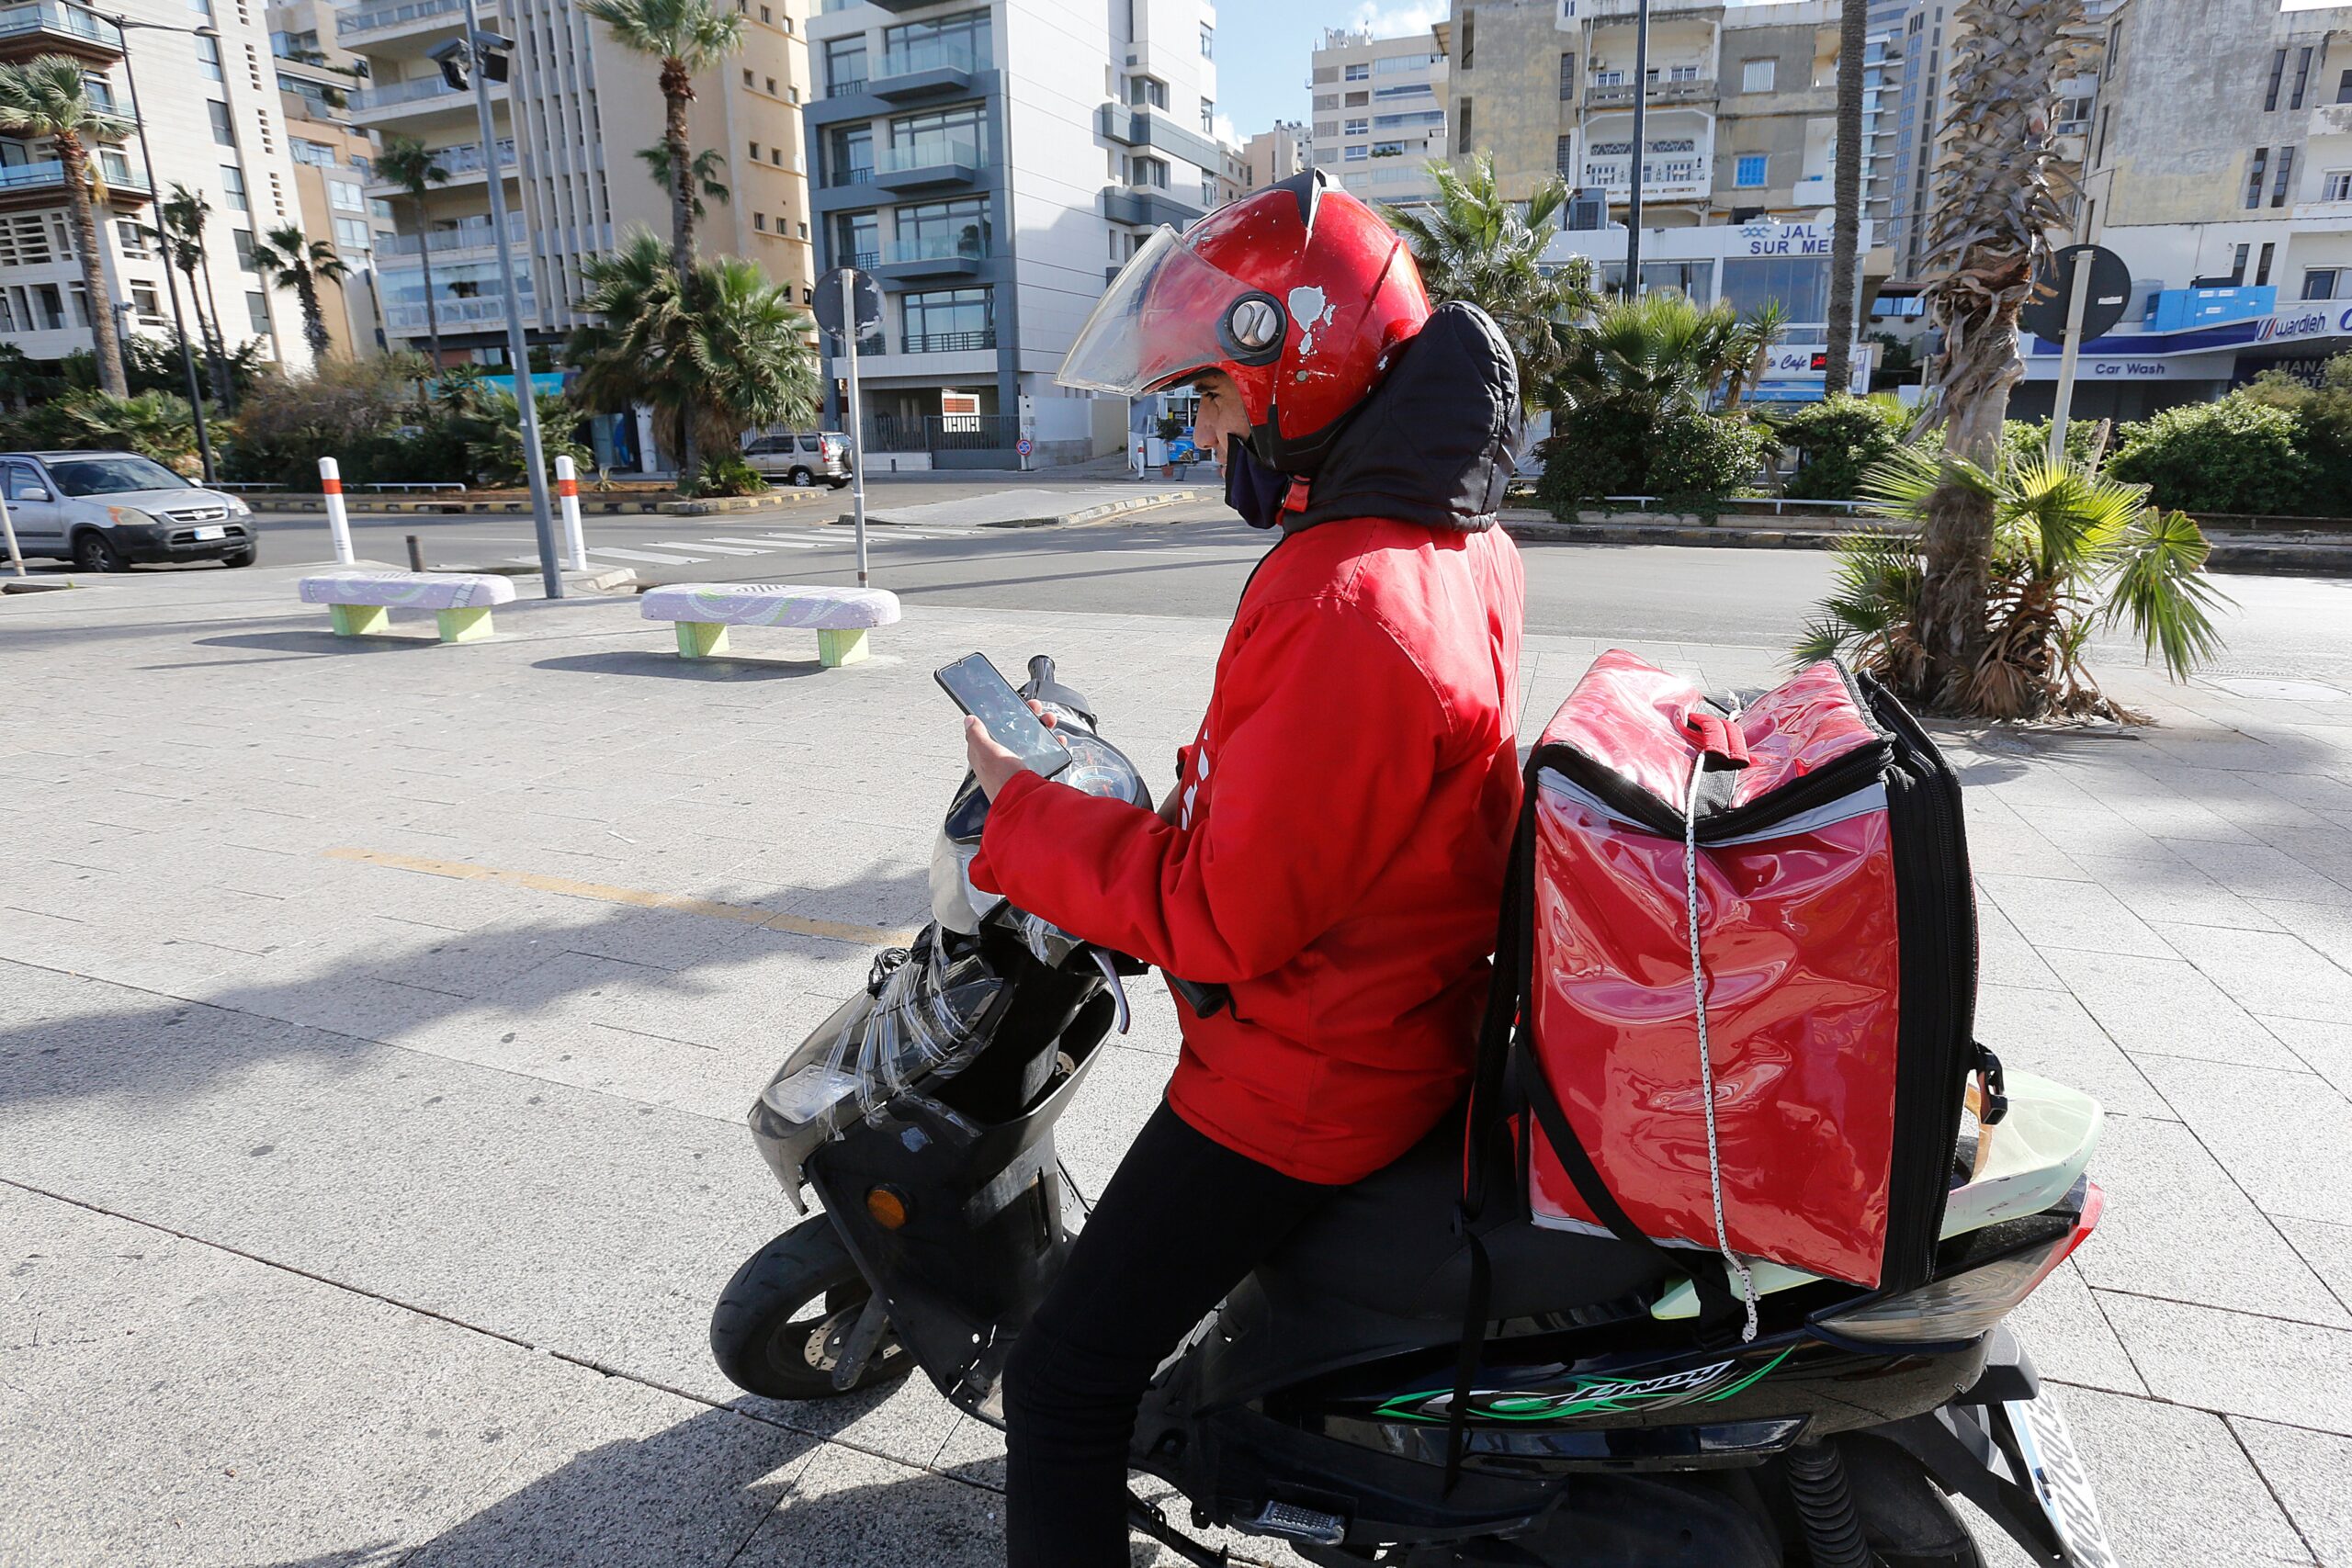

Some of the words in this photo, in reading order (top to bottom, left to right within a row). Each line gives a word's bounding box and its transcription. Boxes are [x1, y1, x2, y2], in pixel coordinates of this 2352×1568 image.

[1781, 225, 1817, 239] JAL
[1750, 241, 1790, 254] SUR
[2275, 311, 2326, 336] wardieh
[1781, 354, 1808, 371] Cafe
[2096, 363, 2121, 374] Car
[2126, 363, 2165, 375] Wash
[2275, 360, 2326, 372] MANA
